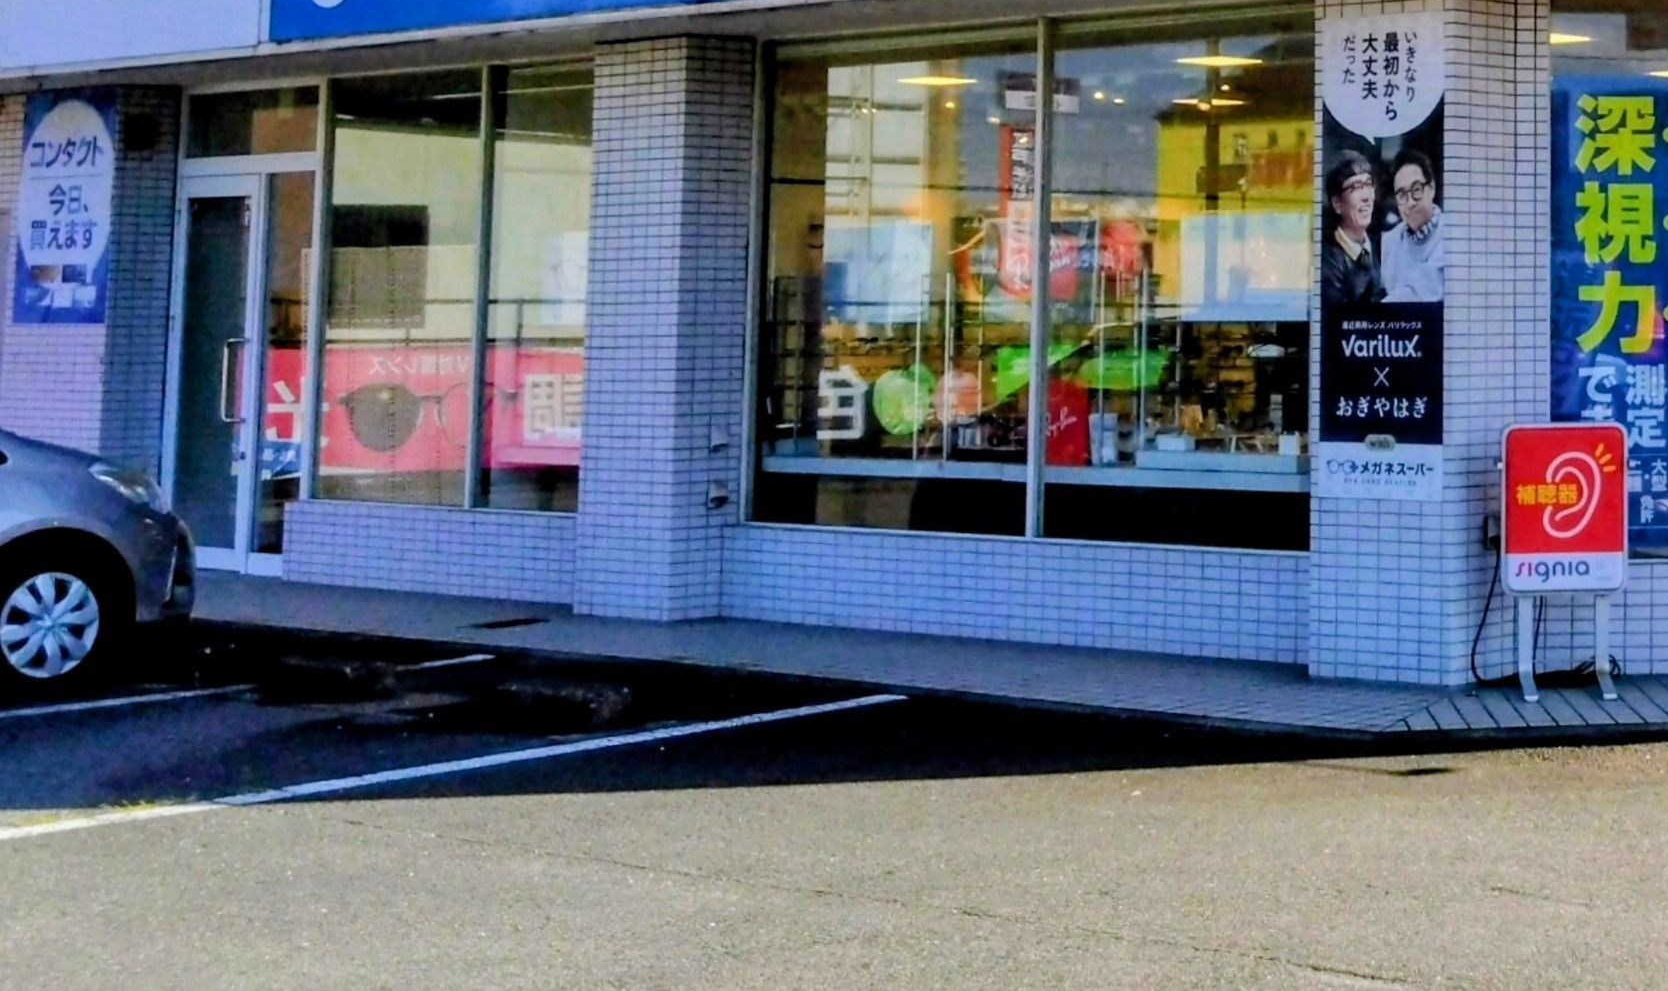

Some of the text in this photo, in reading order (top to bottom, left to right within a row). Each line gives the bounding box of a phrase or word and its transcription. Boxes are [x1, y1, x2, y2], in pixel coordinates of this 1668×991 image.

[1342, 34, 1356, 85] だった
[1362, 32, 1379, 100] 大丈夫
[1383, 31, 1400, 122] 最初から
[1404, 31, 1418, 103] いきなり
[29, 135, 104, 169] コンタクト
[48, 183, 89, 216] 今日、
[29, 218, 98, 251] 買えます
[1574, 94, 1657, 356] 深視力
[1335, 395, 1428, 419] おぎやはぎ
[1624, 363, 1668, 448] 測定
[1368, 437, 1391, 449] with
[1359, 461, 1435, 477] メガネスーパー
[1651, 458, 1668, 492] 大型
[1515, 483, 1579, 505] 補聴器
